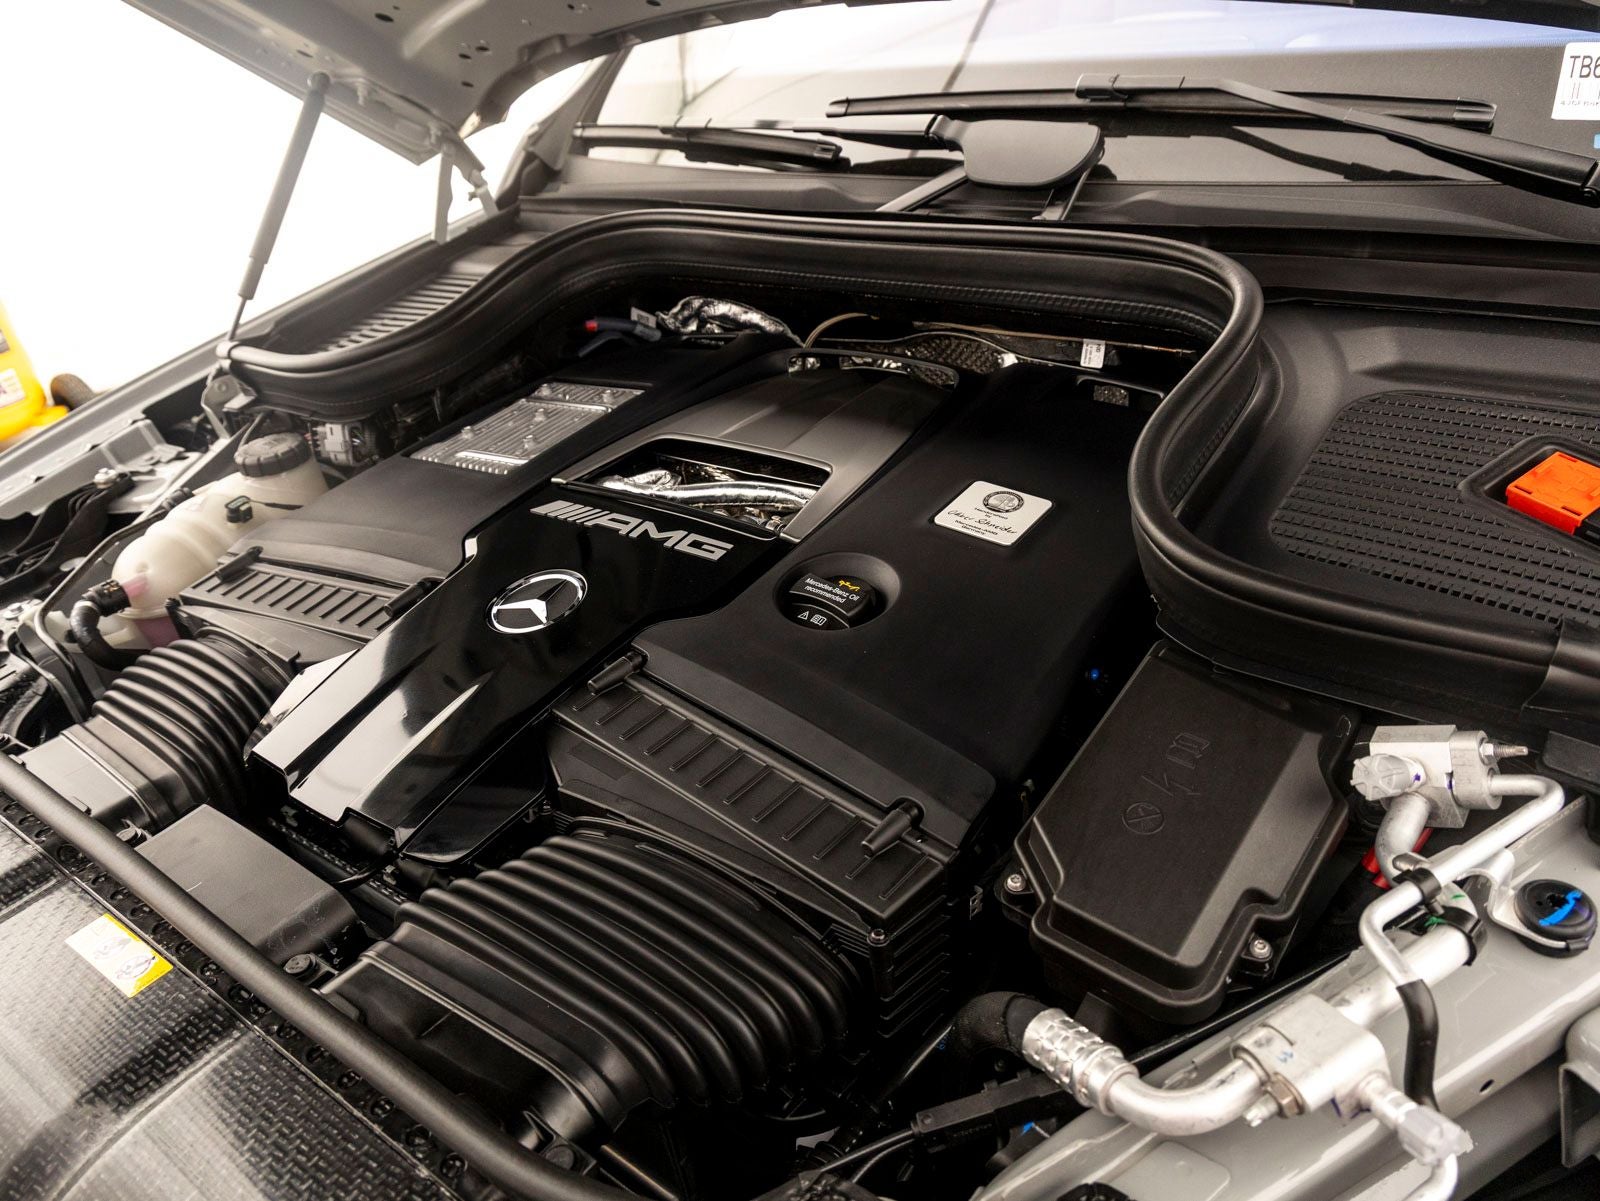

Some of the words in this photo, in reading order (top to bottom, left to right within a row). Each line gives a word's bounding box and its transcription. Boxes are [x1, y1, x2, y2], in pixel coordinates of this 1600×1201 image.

[583, 512, 735, 562] AMG
[804, 585, 847, 603] recommended
[805, 578, 849, 597] Mercedes-Benz
[848, 593, 860, 602] Oil
